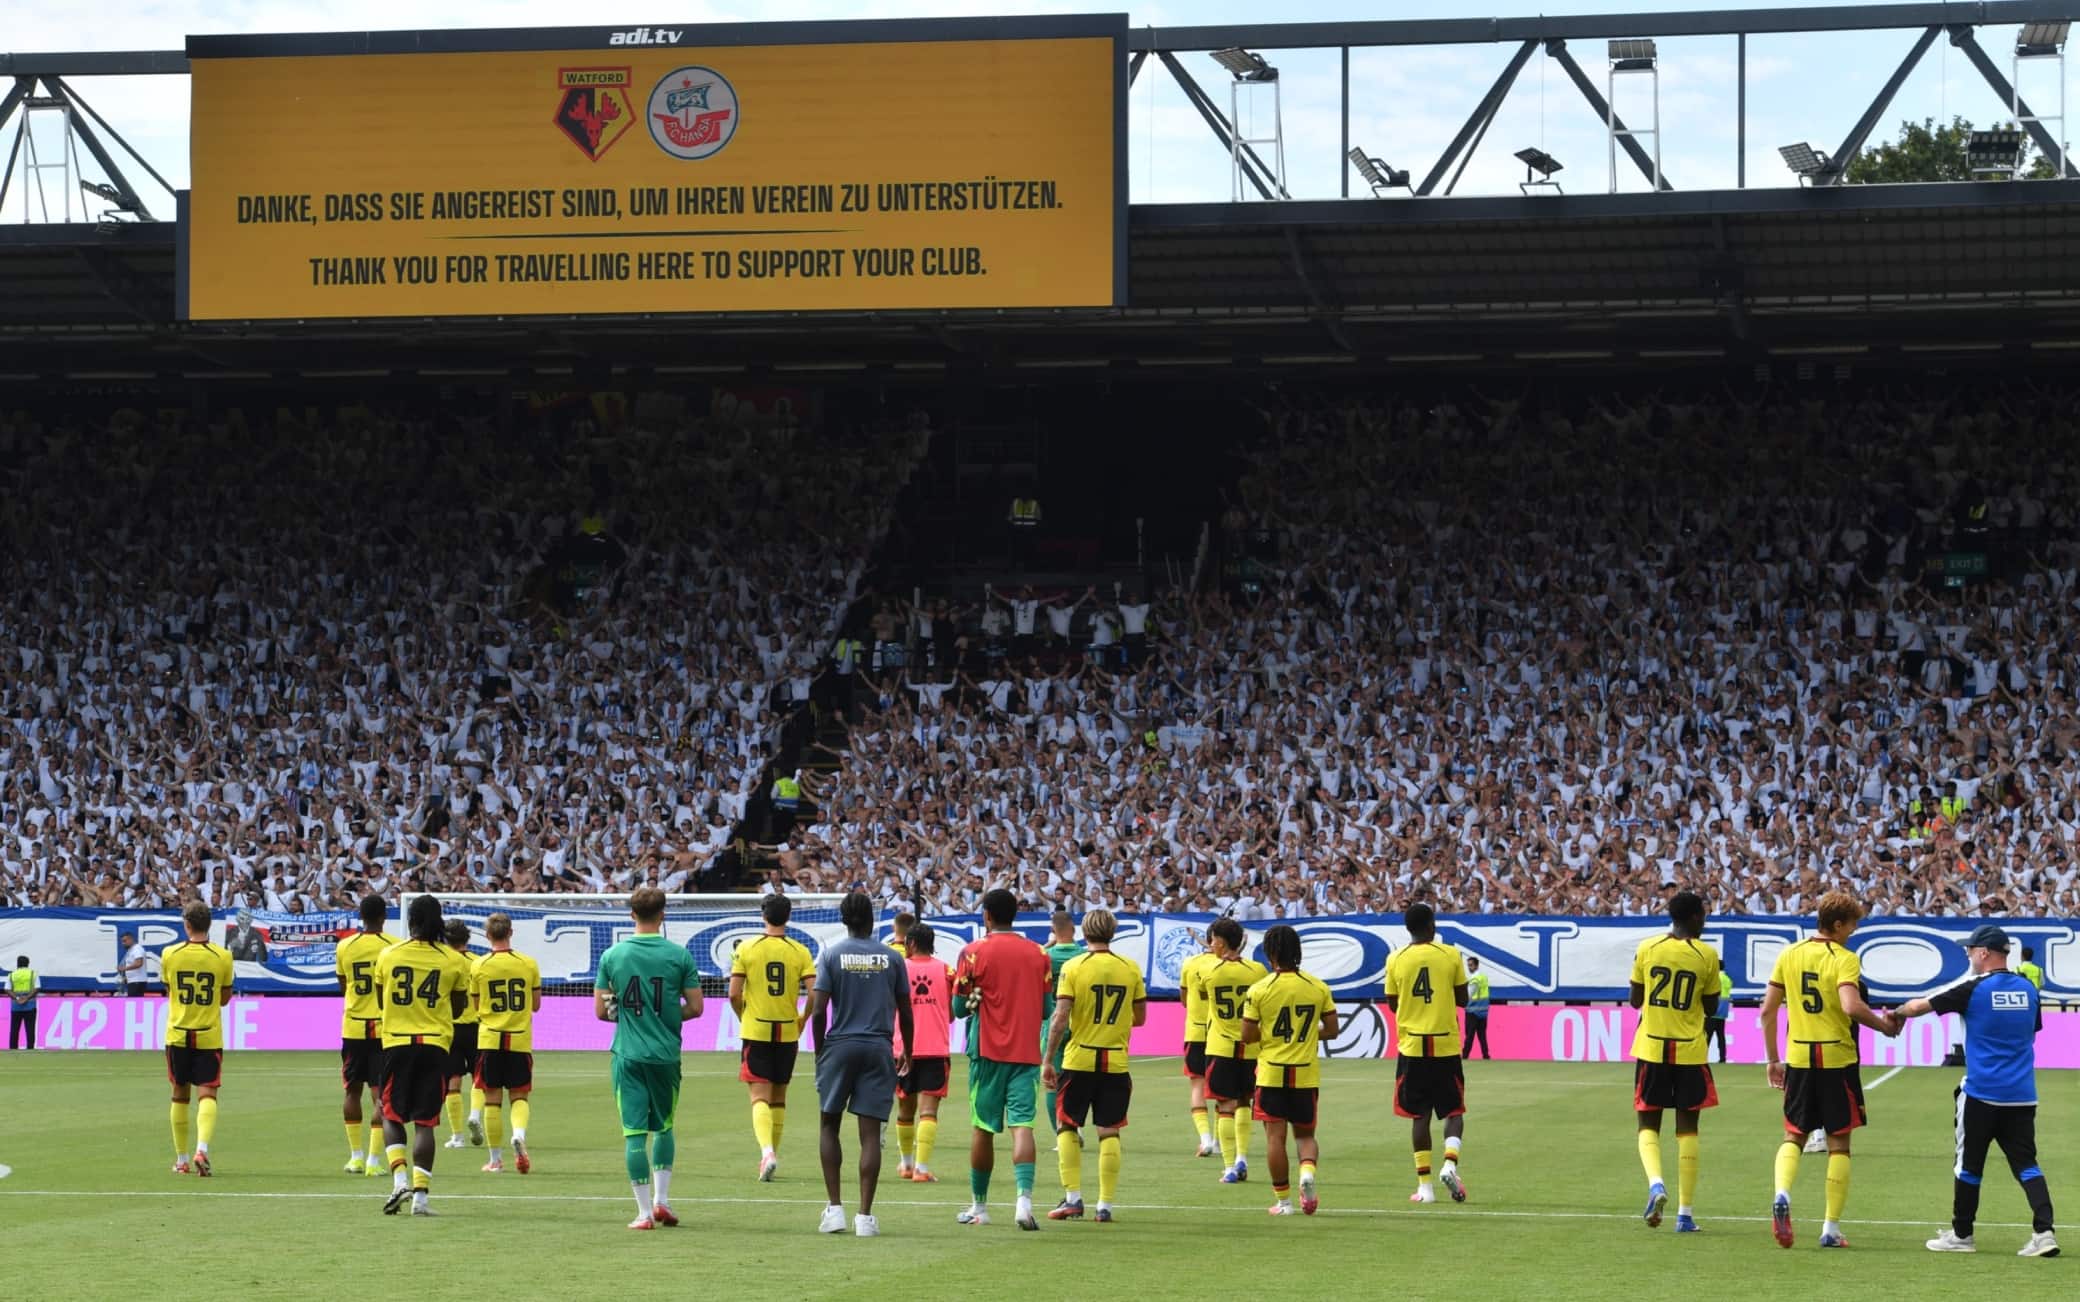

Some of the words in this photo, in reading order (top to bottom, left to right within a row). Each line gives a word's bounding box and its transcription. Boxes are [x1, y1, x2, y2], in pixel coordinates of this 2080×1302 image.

[609, 28, 683, 45] adi.tv
[566, 73, 625, 83] WATFORD
[680, 119, 711, 143] HANSA
[237, 194, 317, 226] DANKE,
[324, 192, 384, 222] DASS
[389, 192, 425, 221] SIE
[431, 189, 556, 220] ANGEREIST
[562, 188, 622, 221] SIND,
[629, 187, 669, 217] UM
[676, 186, 745, 216] IHREN
[751, 184, 833, 214] VEREIN
[840, 183, 870, 213] ZU
[877, 175, 1063, 212] UNTERSTÜTZEN.
[309, 256, 386, 286] THANK
[392, 255, 438, 285] YOU
[445, 255, 488, 284] FOR
[494, 252, 630, 283] TRAVELLING
[637, 251, 695, 281] HERE
[701, 250, 731, 279] TO
[737, 249, 846, 279] SUPPORT
[852, 248, 915, 277] YOUR
[921, 247, 987, 276] CLUB.
[353, 960, 377, 996] 5
[765, 961, 785, 997] 9
[840, 954, 889, 969] HORNETS
[177, 970, 216, 1007] 53
[391, 966, 441, 1008] 34
[488, 978, 526, 1013] 56
[623, 975, 664, 1017] 41
[1215, 985, 1250, 1020] 52
[1412, 966, 1434, 1004] 4
[1649, 965, 1697, 1011] 20
[1801, 972, 1823, 1014] 5
[1993, 994, 2026, 1005] SLT
[1090, 984, 1128, 1025] 17
[45, 1000, 109, 1050] 42
[123, 1000, 260, 1051] HE
[1271, 1004, 1316, 1044] 47
[1551, 1008, 1623, 1063] ON
